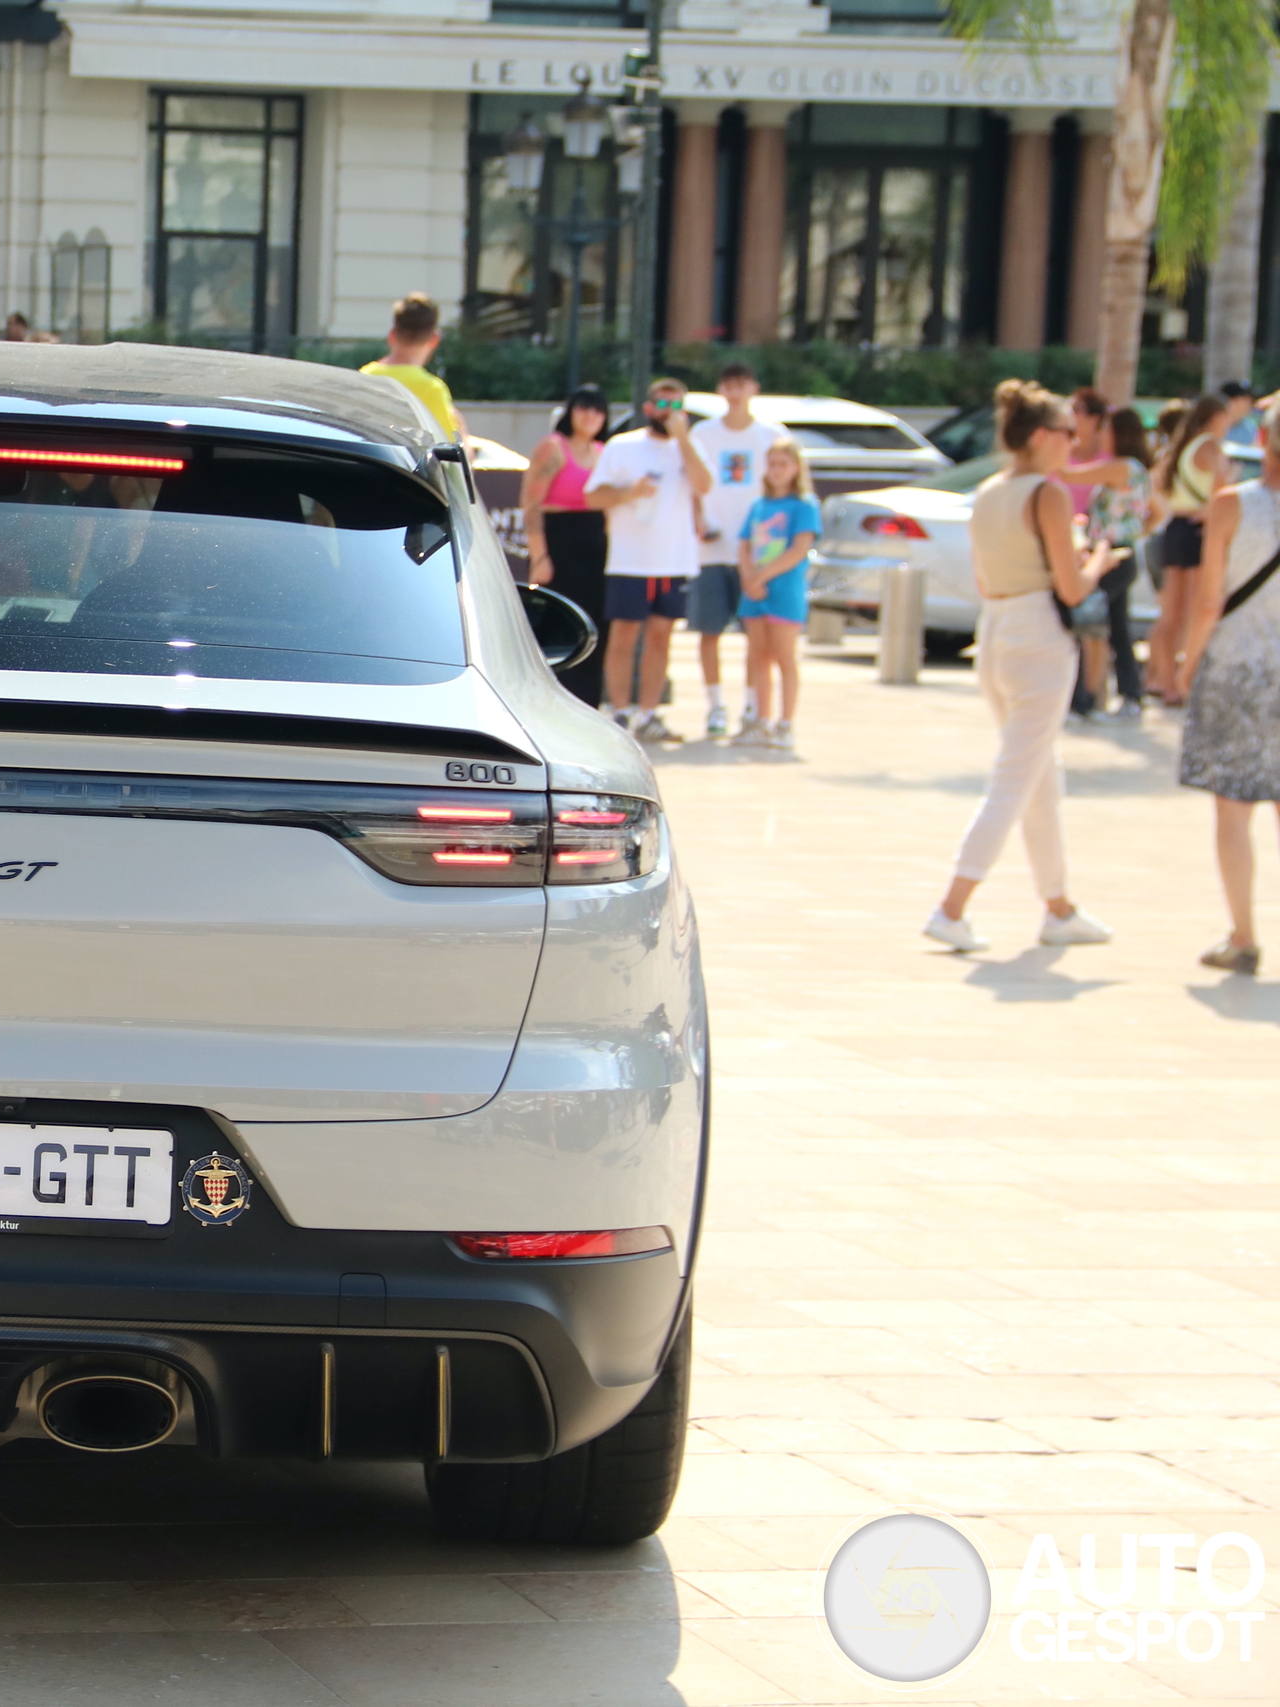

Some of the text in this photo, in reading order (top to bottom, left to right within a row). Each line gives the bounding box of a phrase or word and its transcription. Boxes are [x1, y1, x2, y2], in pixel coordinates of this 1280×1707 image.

[472, 60, 517, 85] LE
[544, 62, 666, 86] LOU
[694, 65, 745, 90] XV
[916, 69, 1105, 99] DUCASSE
[445, 761, 517, 786] 800
[183, 1170, 195, 1193] YACHT
[192, 1158, 210, 1171] CLUB
[230, 1163, 249, 1193] MONACO
